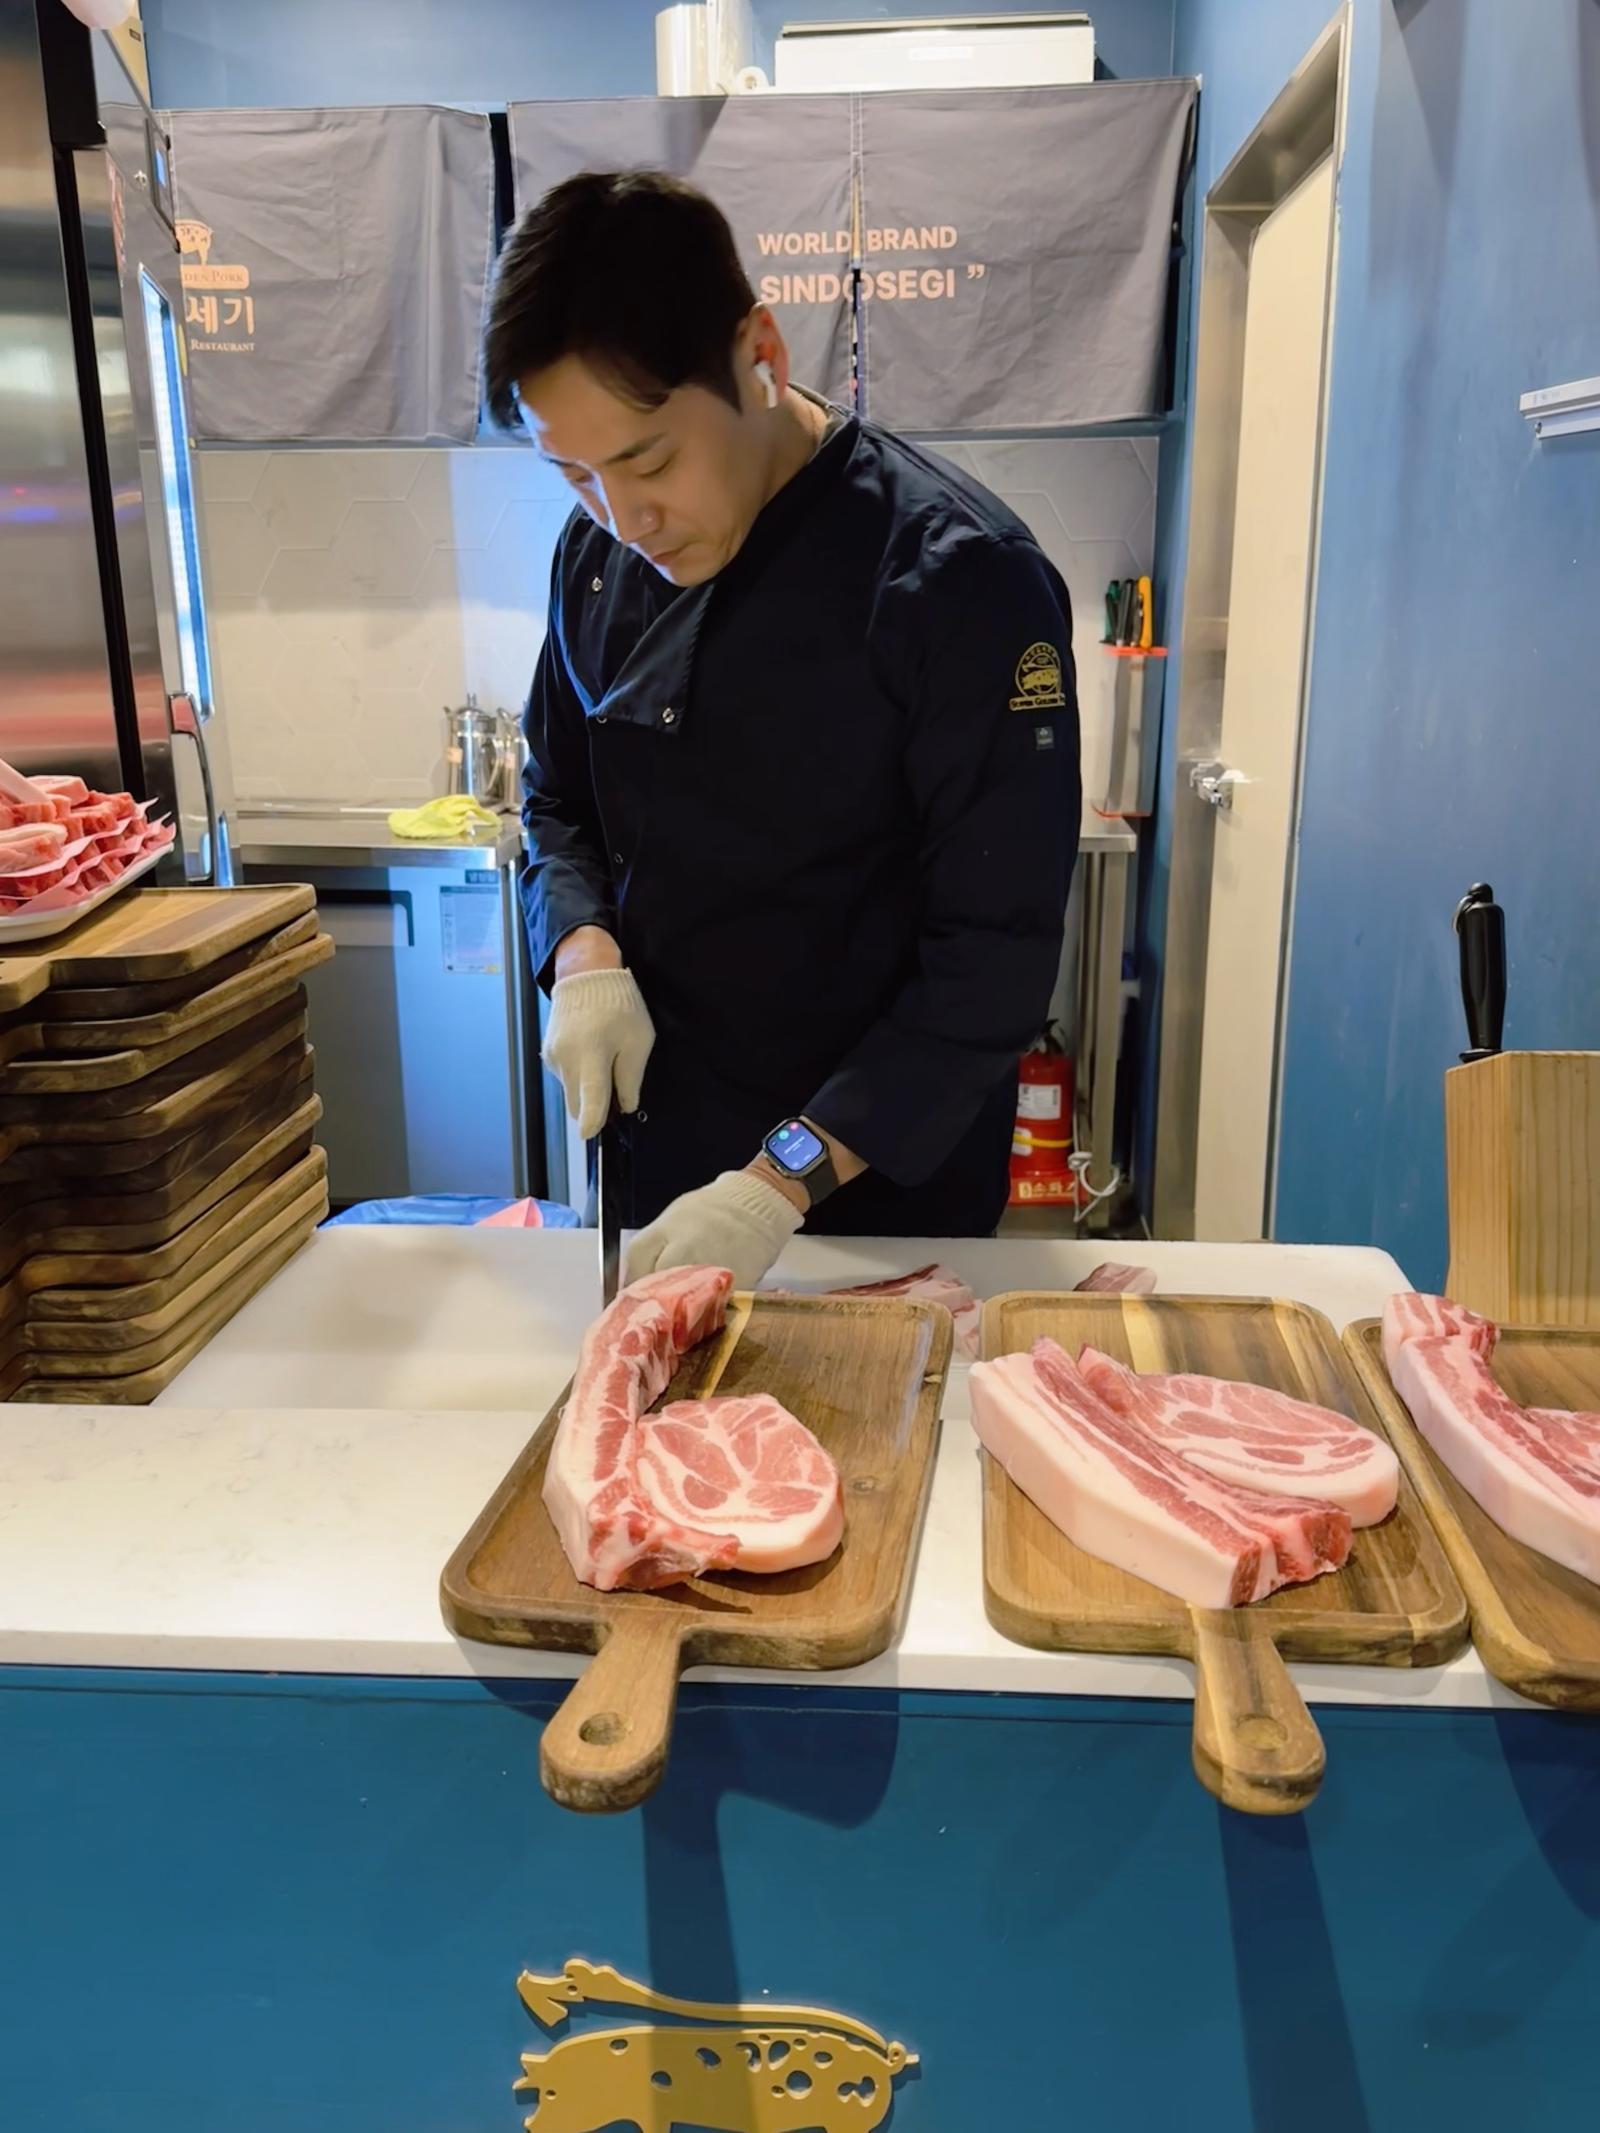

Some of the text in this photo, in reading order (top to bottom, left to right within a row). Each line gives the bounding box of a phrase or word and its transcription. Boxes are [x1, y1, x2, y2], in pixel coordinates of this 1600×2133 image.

[757, 226, 957, 256] WORLD BRAND
[760, 269, 955, 305] SINDOSEGI
[191, 338, 255, 351] RESTAURANT
